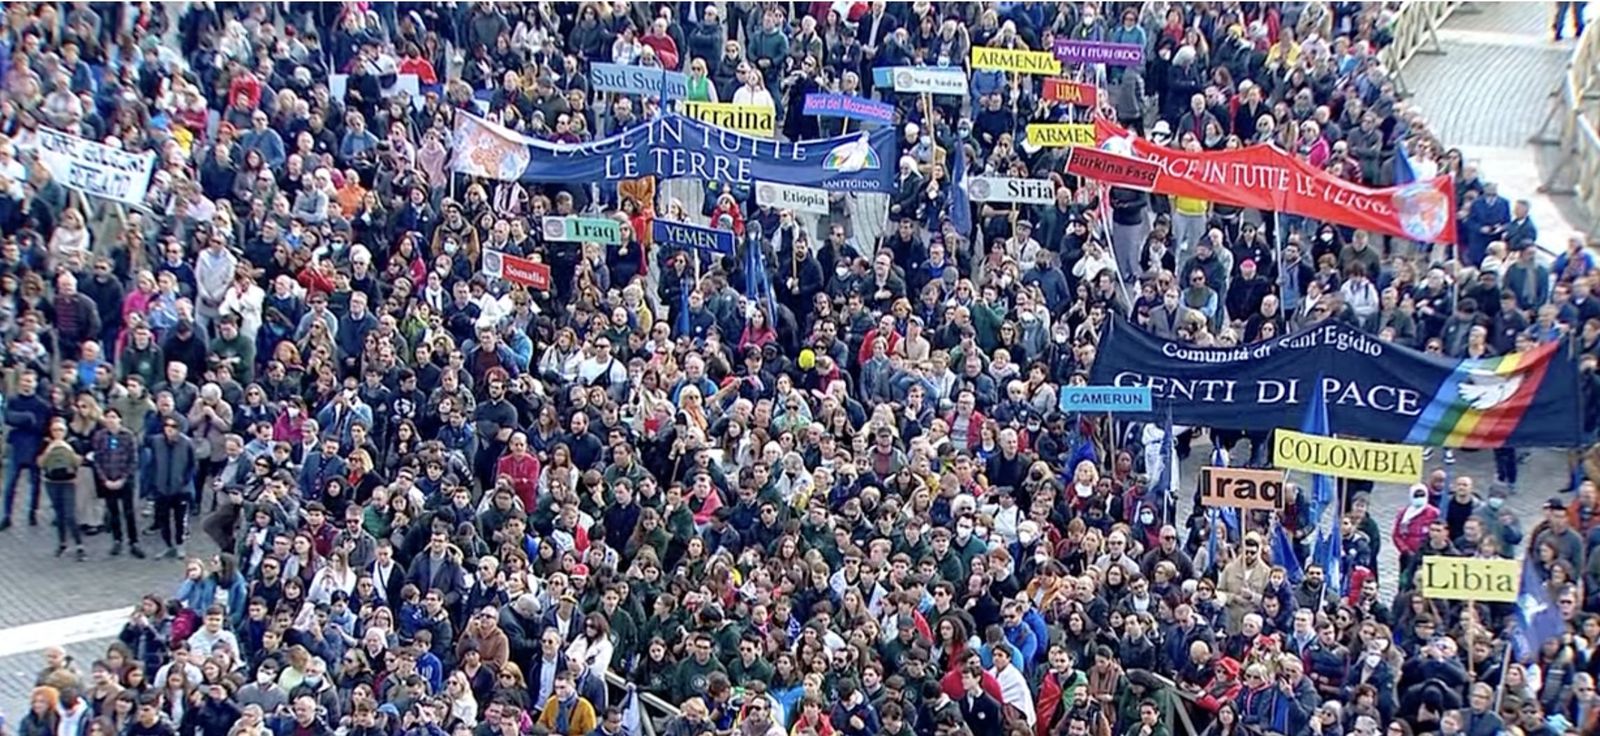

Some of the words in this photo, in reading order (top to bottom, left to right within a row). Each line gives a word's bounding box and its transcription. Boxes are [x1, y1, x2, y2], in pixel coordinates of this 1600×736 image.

[978, 52, 1054, 70] ARMENIA
[592, 69, 627, 87] Sud
[1055, 84, 1082, 102] LIBIA
[806, 96, 826, 110] Nord
[828, 98, 841, 110] del
[843, 99, 892, 119] Mozambico
[647, 119, 682, 145] IN
[605, 153, 639, 179] LE
[649, 147, 752, 183] TERRE
[1072, 153, 1123, 173] Burkina
[1126, 166, 1156, 180] Faso
[1201, 159, 1227, 184] IN
[1232, 163, 1290, 191] TUTTE
[783, 190, 825, 207] Etiopia
[1008, 181, 1054, 199] Siria
[574, 221, 616, 242] Iraq
[665, 226, 718, 249] YEMEN
[506, 264, 545, 285] Somalia
[1070, 392, 1143, 405] CAMERUN
[1256, 379, 1299, 404] DI
[1321, 377, 1422, 416] PACE
[1278, 436, 1418, 475] COLOMBIA
[1202, 468, 1283, 509] Iraq
[1425, 562, 1514, 592] Libia
